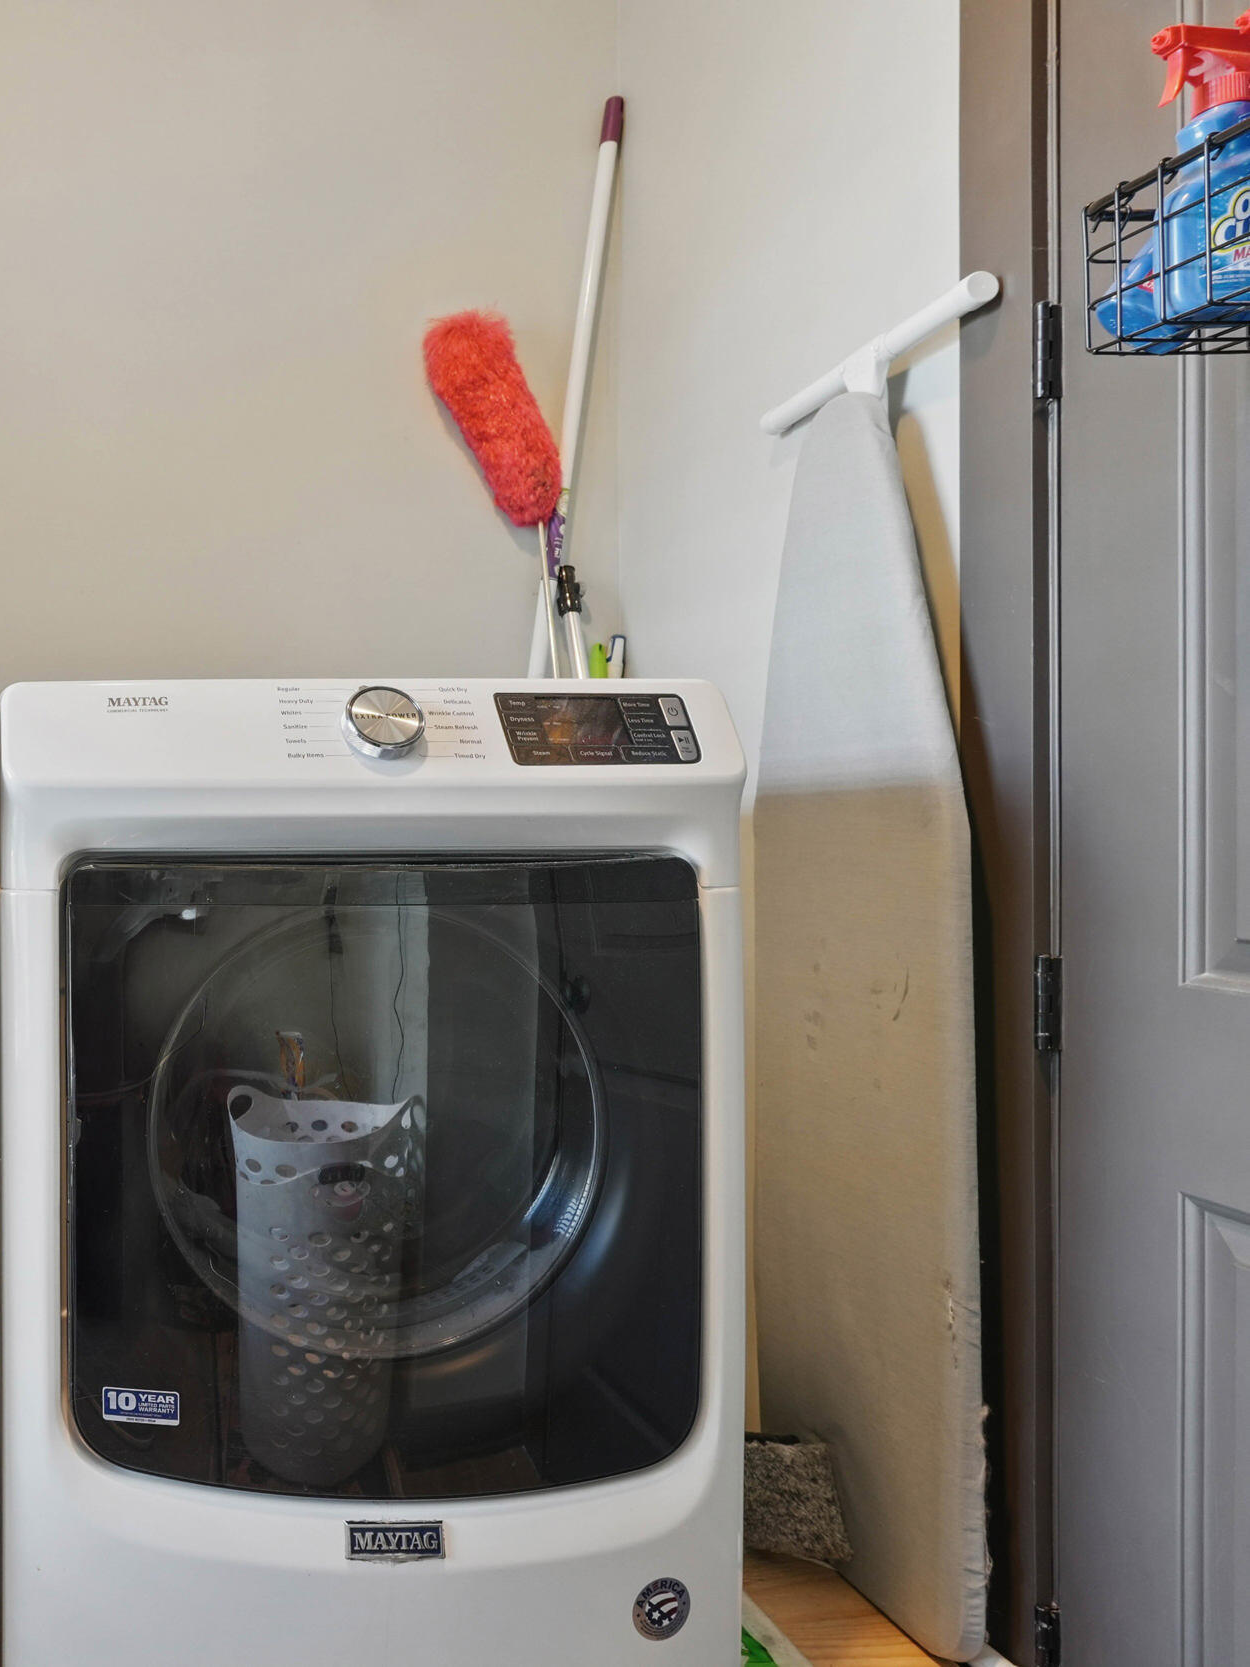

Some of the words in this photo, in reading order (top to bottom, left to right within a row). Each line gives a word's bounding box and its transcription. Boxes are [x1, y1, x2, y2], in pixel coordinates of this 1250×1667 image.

[107, 697, 168, 707] MAYTAG
[107, 1391, 137, 1411] 10
[139, 1394, 174, 1403] YEAR
[353, 1532, 438, 1550] MAYTAG
[636, 1580, 686, 1609] AMERICA
